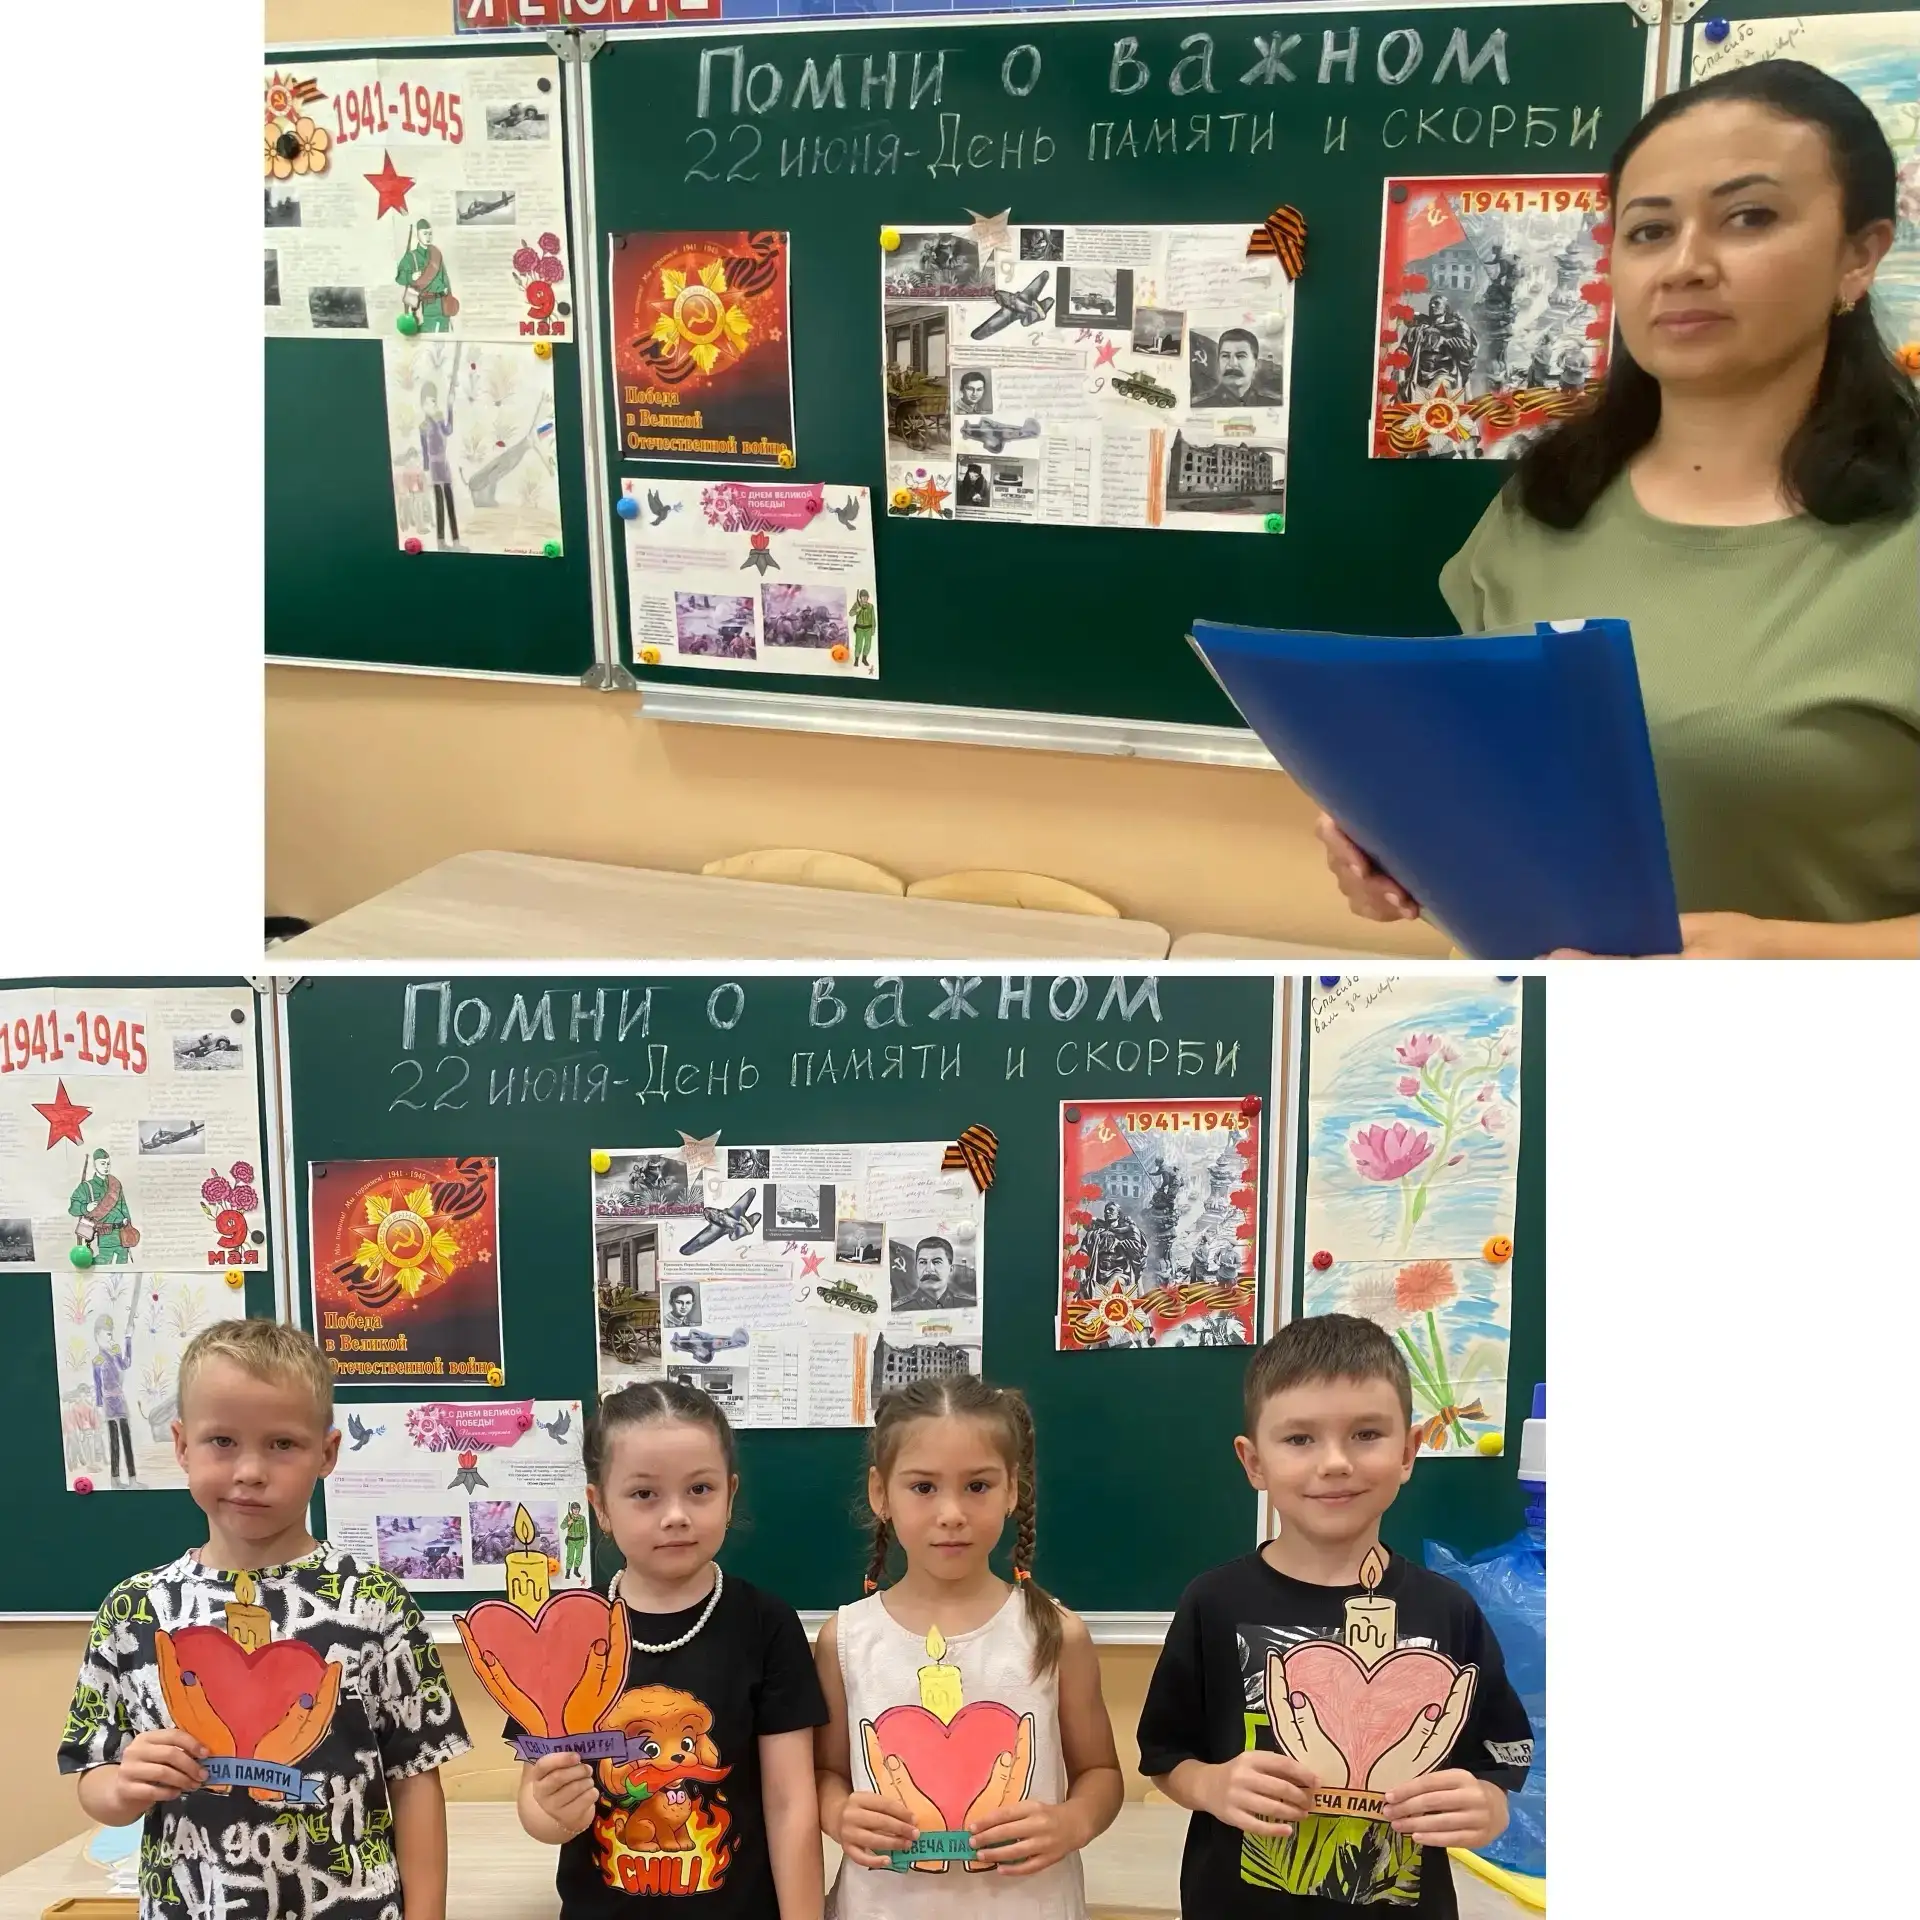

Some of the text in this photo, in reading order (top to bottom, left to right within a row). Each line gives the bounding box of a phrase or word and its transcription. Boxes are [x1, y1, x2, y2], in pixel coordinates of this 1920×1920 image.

[1692, 23, 1754, 76] Спасибо
[697, 44, 945, 118] Помни
[332, 81, 464, 145] 1941-1945
[684, 124, 763, 183] 22
[1088, 111, 1275, 161] ПАМЯТИ
[1382, 105, 1604, 150] СКОРБИ
[624, 386, 681, 407] Победа
[626, 409, 704, 429] в Великой
[627, 432, 738, 454] Отечественной
[748, 491, 773, 499] ДНЕМ
[402, 980, 652, 1050] Помни
[0, 1009, 148, 1074] 1941-1945
[388, 1055, 471, 1112] 22
[789, 1041, 961, 1087] ПАМЯТИ
[1056, 1037, 1241, 1077] СКОРБИ
[1126, 1111, 1251, 1132] 1941-1945
[215, 1209, 248, 1248] 9
[324, 1312, 383, 1331] Победа
[326, 1334, 408, 1351] в Великой
[328, 1357, 444, 1375] Отечественной
[455, 1418, 495, 1428] ПОБЕДЫ!
[456, 1410, 481, 1419] ДНЕМ
[483, 1407, 522, 1417] ВЕЛИКОЙ
[235, 1765, 292, 1788] ПАМЯТИ
[1347, 1796, 1386, 1814] ПАМ
[617, 1854, 703, 1895] CHILI
